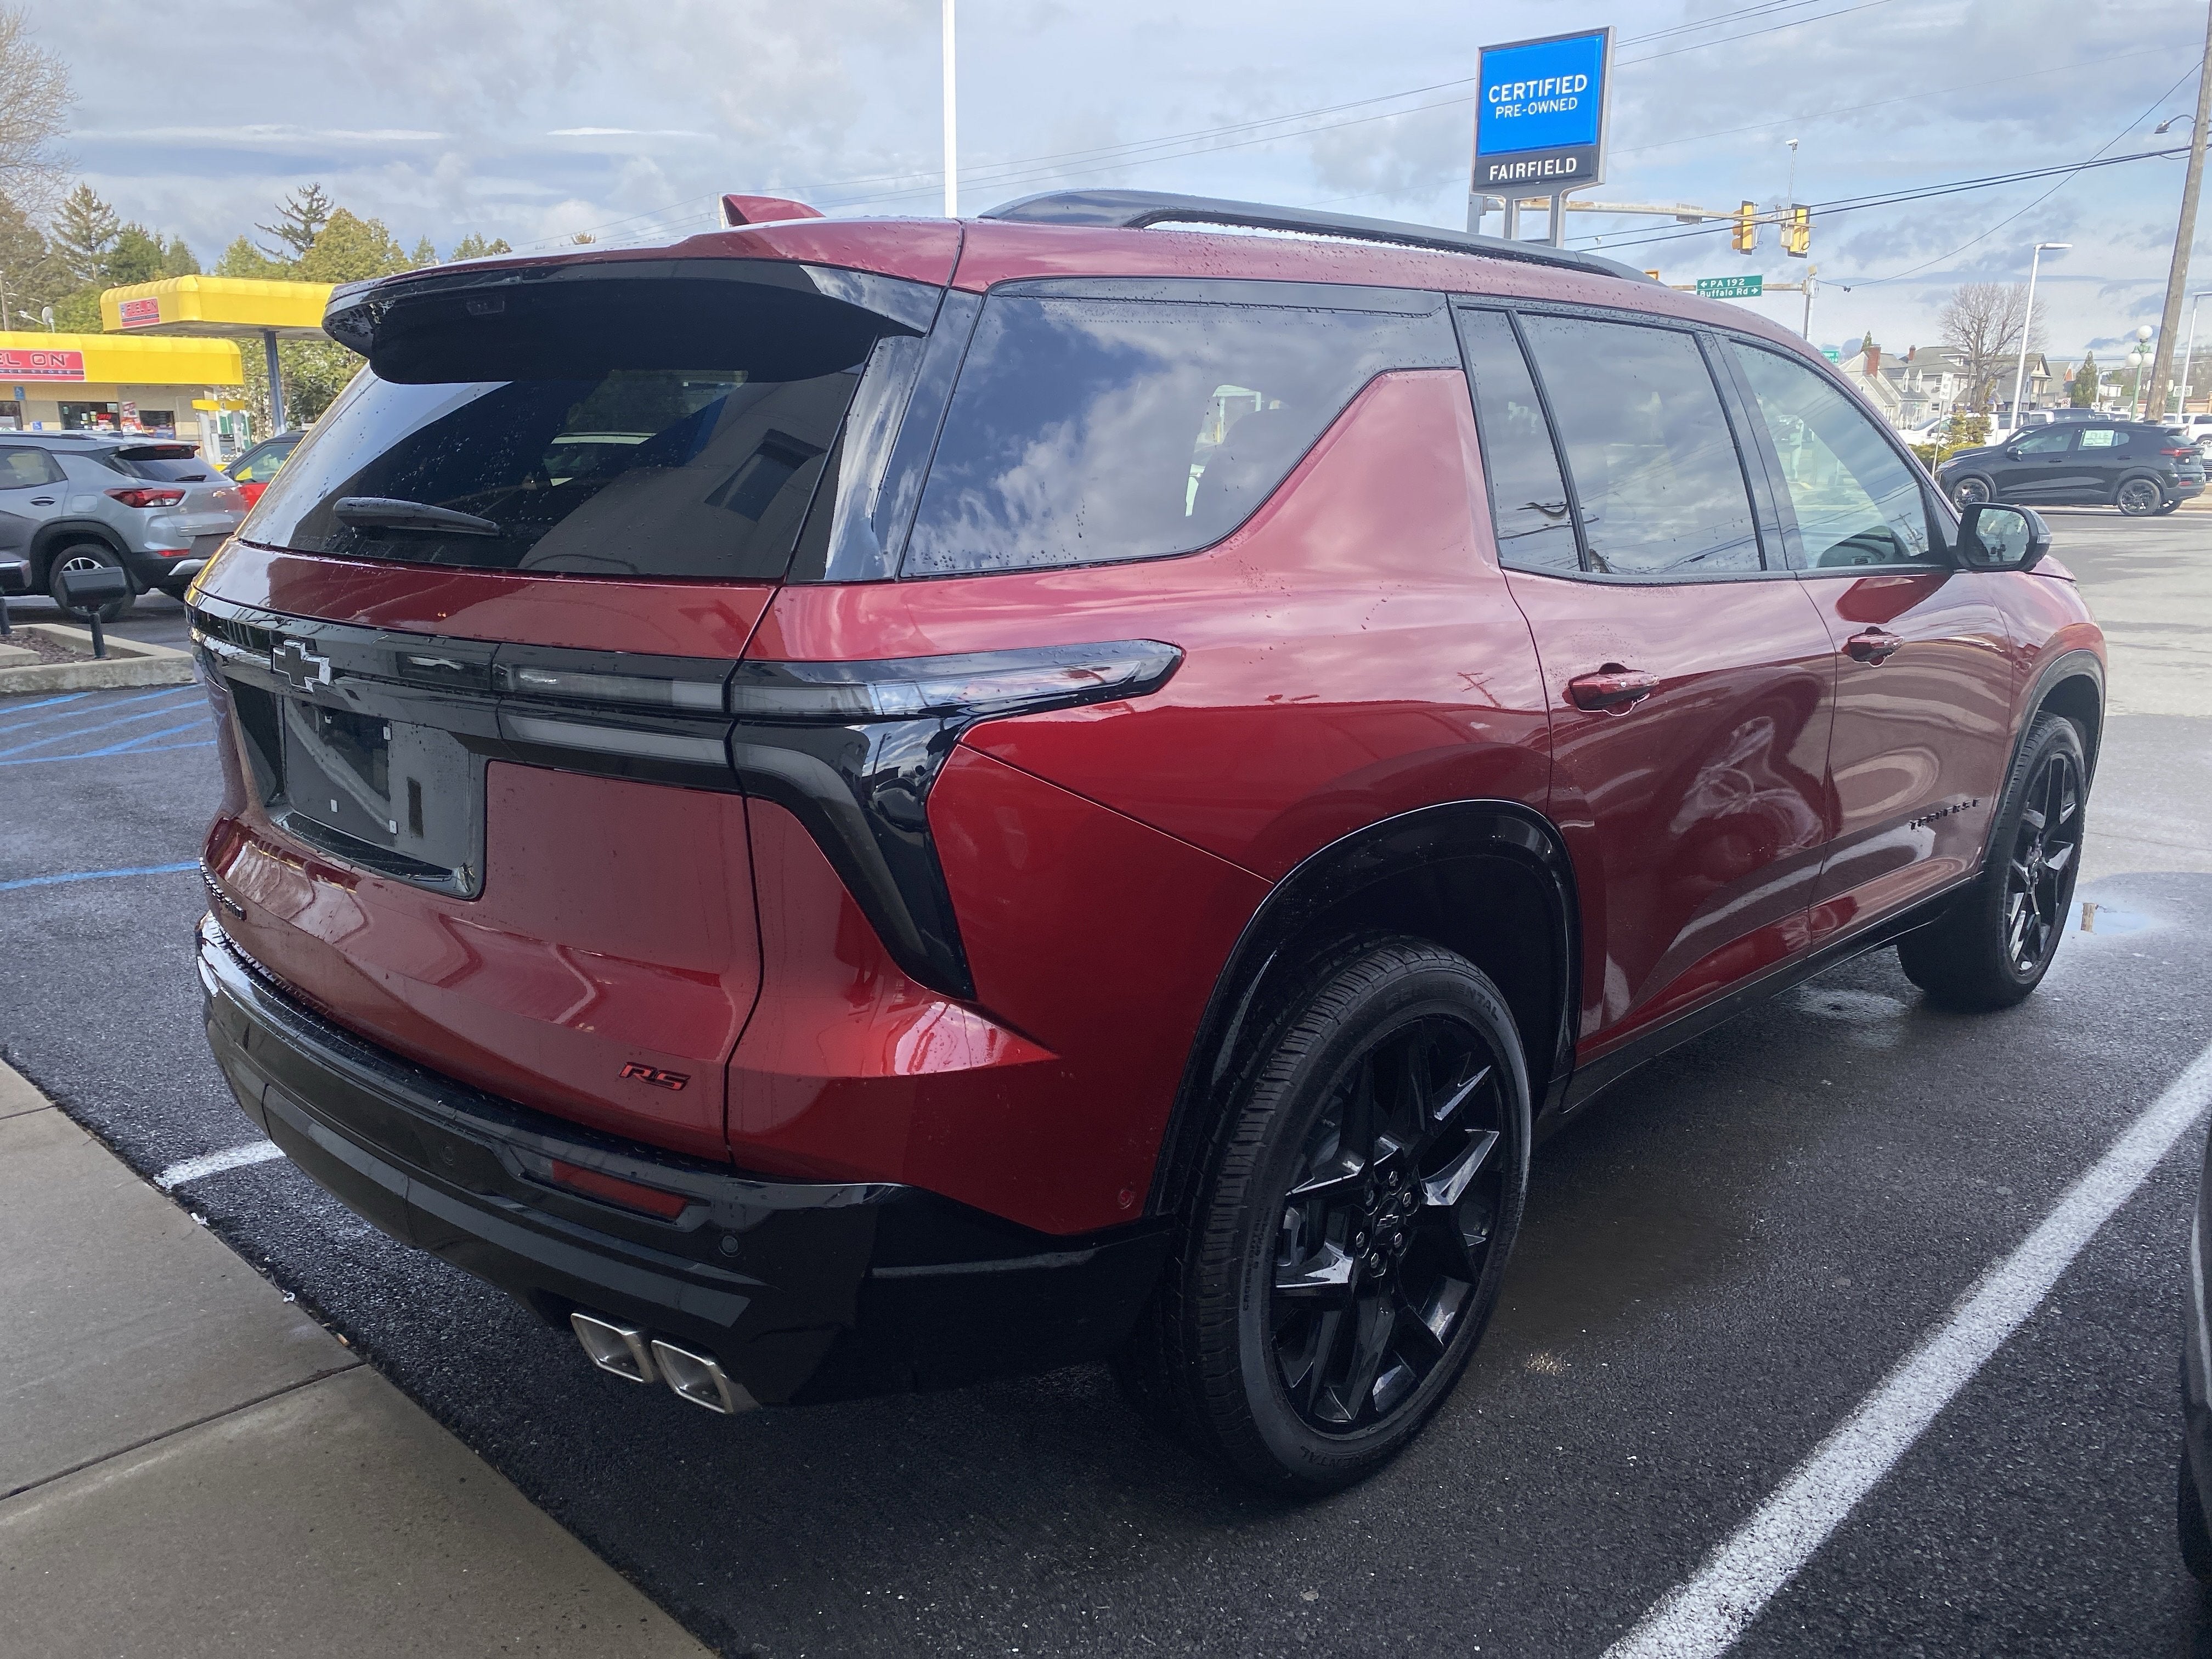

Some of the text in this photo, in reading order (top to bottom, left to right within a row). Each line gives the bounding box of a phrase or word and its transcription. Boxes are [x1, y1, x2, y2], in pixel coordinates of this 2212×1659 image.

[1488, 74, 1588, 103] CERTIFIED
[1496, 97, 1578, 119] PRE-OWNED
[1489, 157, 1577, 180] FAIRFIELD
[1727, 278, 1745, 286] 192
[1700, 289, 1733, 297] Buffalo
[127, 301, 156, 314] FUEL ON
[0, 353, 65, 365] L ON
[618, 1062, 691, 1091] RS
